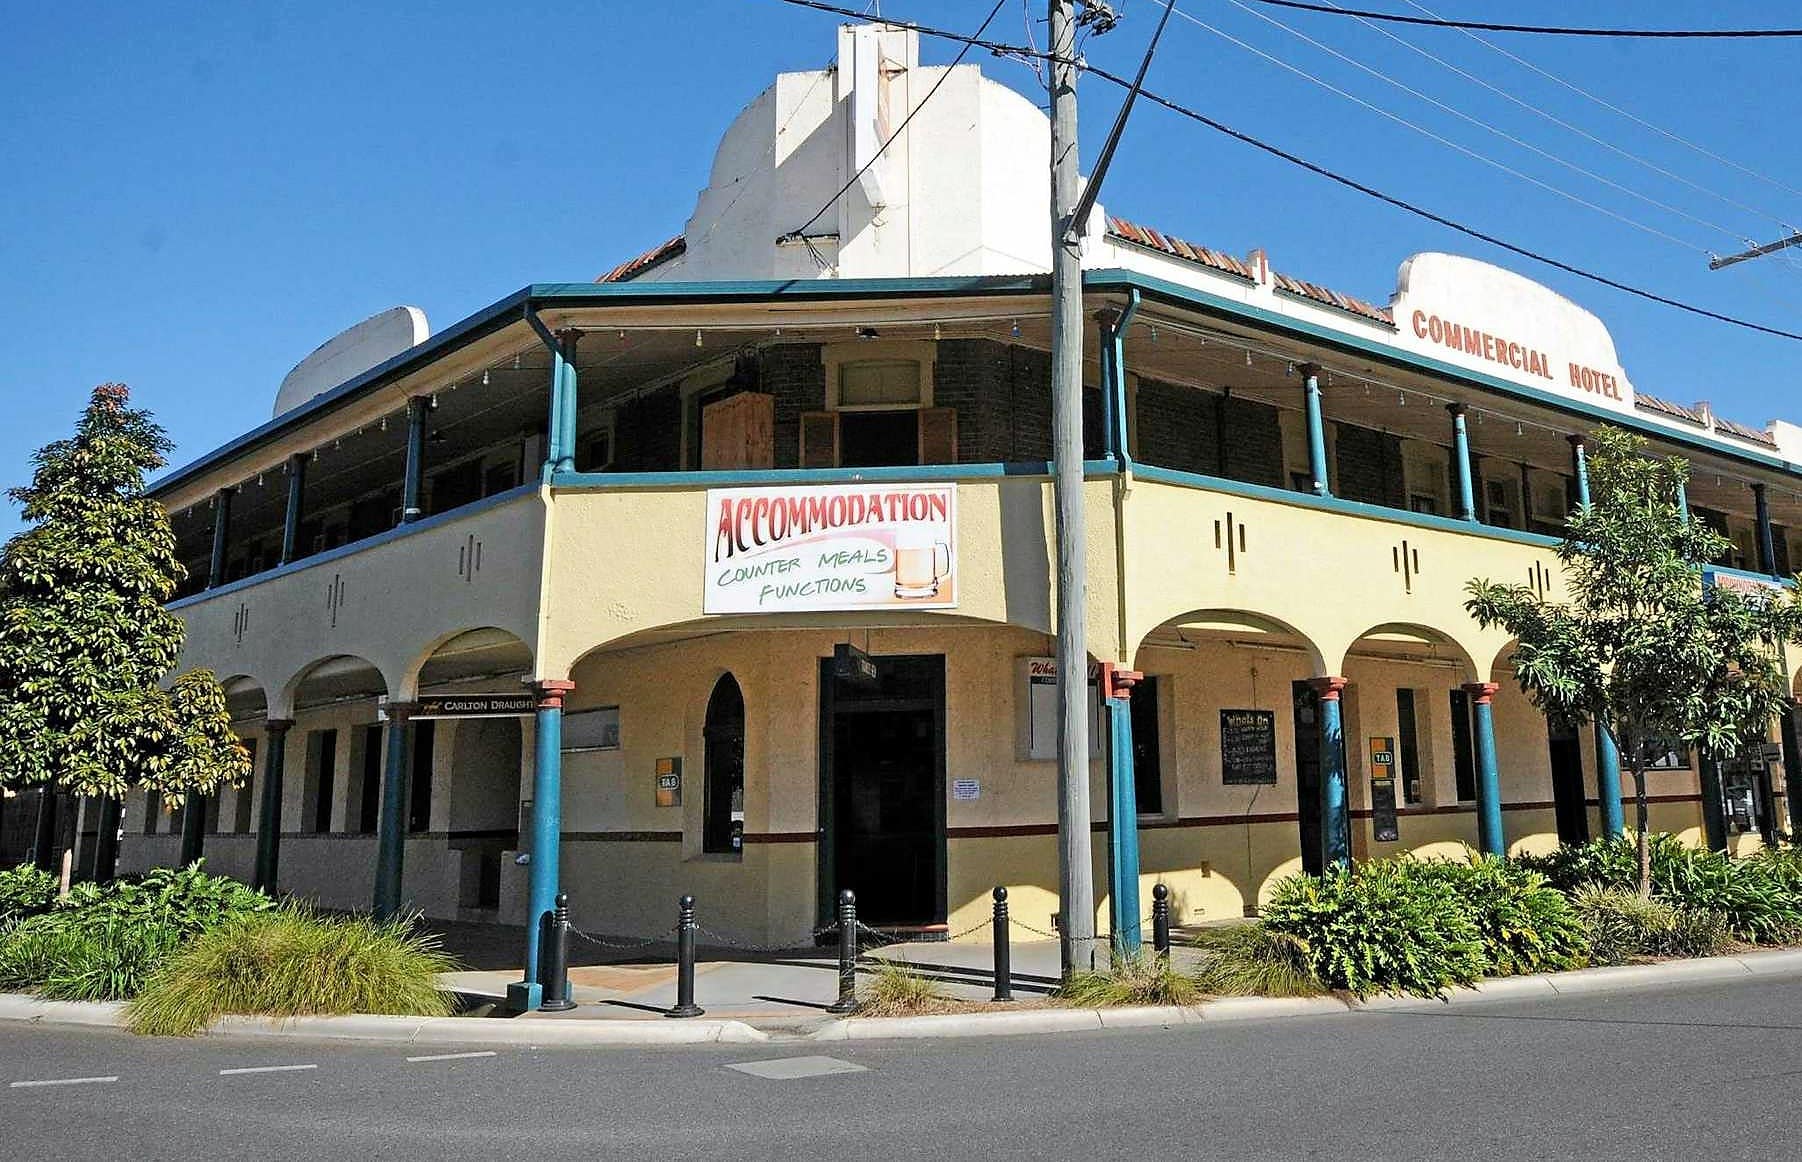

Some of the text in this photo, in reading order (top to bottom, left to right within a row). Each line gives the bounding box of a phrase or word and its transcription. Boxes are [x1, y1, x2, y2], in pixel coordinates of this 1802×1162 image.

[1411, 309, 1623, 402] COMMERCIAL HOTEL
[714, 492, 947, 563] ACCOMMODATION
[717, 548, 889, 588] COUNTER MEALS
[758, 577, 867, 605] FUNCTIONS
[444, 699, 536, 711] CARLTON DRAUGHT
[1375, 754, 1391, 763] TAB
[661, 776, 678, 787] TAB
